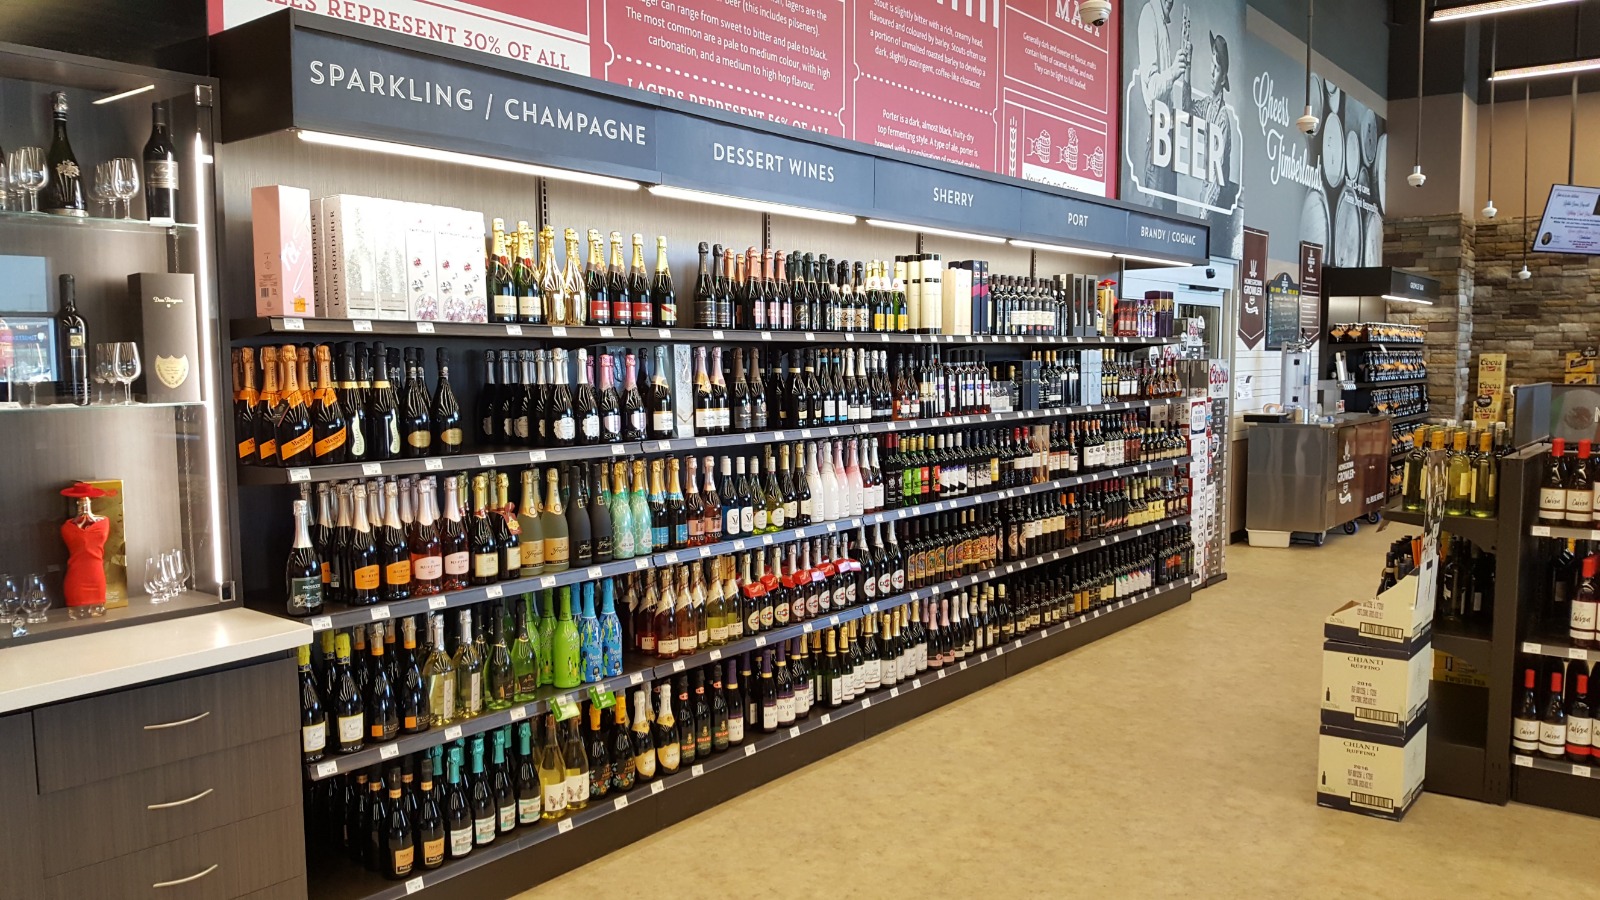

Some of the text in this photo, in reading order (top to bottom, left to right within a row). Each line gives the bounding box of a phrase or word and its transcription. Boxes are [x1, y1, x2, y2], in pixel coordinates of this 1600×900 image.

[760, 6, 787, 24] includes
[806, 7, 816, 17] are
[816, 9, 827, 21] the
[895, 6, 913, 21] slightly
[914, 13, 928, 26] bitter
[929, 19, 939, 30] with
[955, 31, 971, 45] creamy
[327, 0, 570, 70] REPRESENT 30% OF ALL
[661, 1, 675, 12] can
[677, 6, 699, 21] range
[701, 10, 719, 25] from
[720, 19, 742, 32] sweet
[744, 25, 751, 36] to
[753, 27, 772, 42] bitter
[774, 36, 785, 47] and
[787, 41, 800, 52] pale
[802, 44, 809, 54] to
[870, 10, 894, 28] flavoured
[896, 21, 905, 32] and
[906, 26, 927, 41] coloured
[928, 33, 934, 46] by
[874, 29, 894, 43] portion
[895, 37, 901, 46] of
[626, 6, 642, 21] The
[644, 14, 665, 28] most
[667, 21, 702, 39] common
[704, 33, 716, 43] are
[724, 38, 739, 50] pale
[740, 43, 748, 53] to
[750, 46, 777, 62] medium
[779, 55, 801, 71] colour,
[802, 62, 816, 74] with
[818, 65, 830, 80] high
[648, 36, 698, 59] carbonation,
[701, 51, 714, 62] and
[723, 57, 752, 72] medium
[753, 65, 760, 75] to
[762, 66, 777, 82] high
[778, 70, 790, 86] hop
[890, 50, 908, 67] slightly
[310, 60, 473, 111] SPARKLING
[504, 98, 646, 145] CHAMPAGNE
[883, 109, 899, 122] Porter
[922, 121, 938, 133] almost
[878, 125, 887, 136] top
[888, 126, 915, 144] fermenting
[934, 141, 944, 150] type
[1152, 100, 1225, 186] BEER
[714, 142, 835, 182] DESSERT WINES
[1267, 129, 1323, 190] Timberlands
[933, 187, 974, 208] SHERRY
[1068, 213, 1088, 227] PORT
[1141, 226, 1166, 240] BRANDY
[1172, 232, 1196, 245] COGNAC
[1209, 364, 1228, 384] Coors
[1348, 656, 1383, 666] CHIANTI
[1343, 741, 1379, 752] CHIANTI
